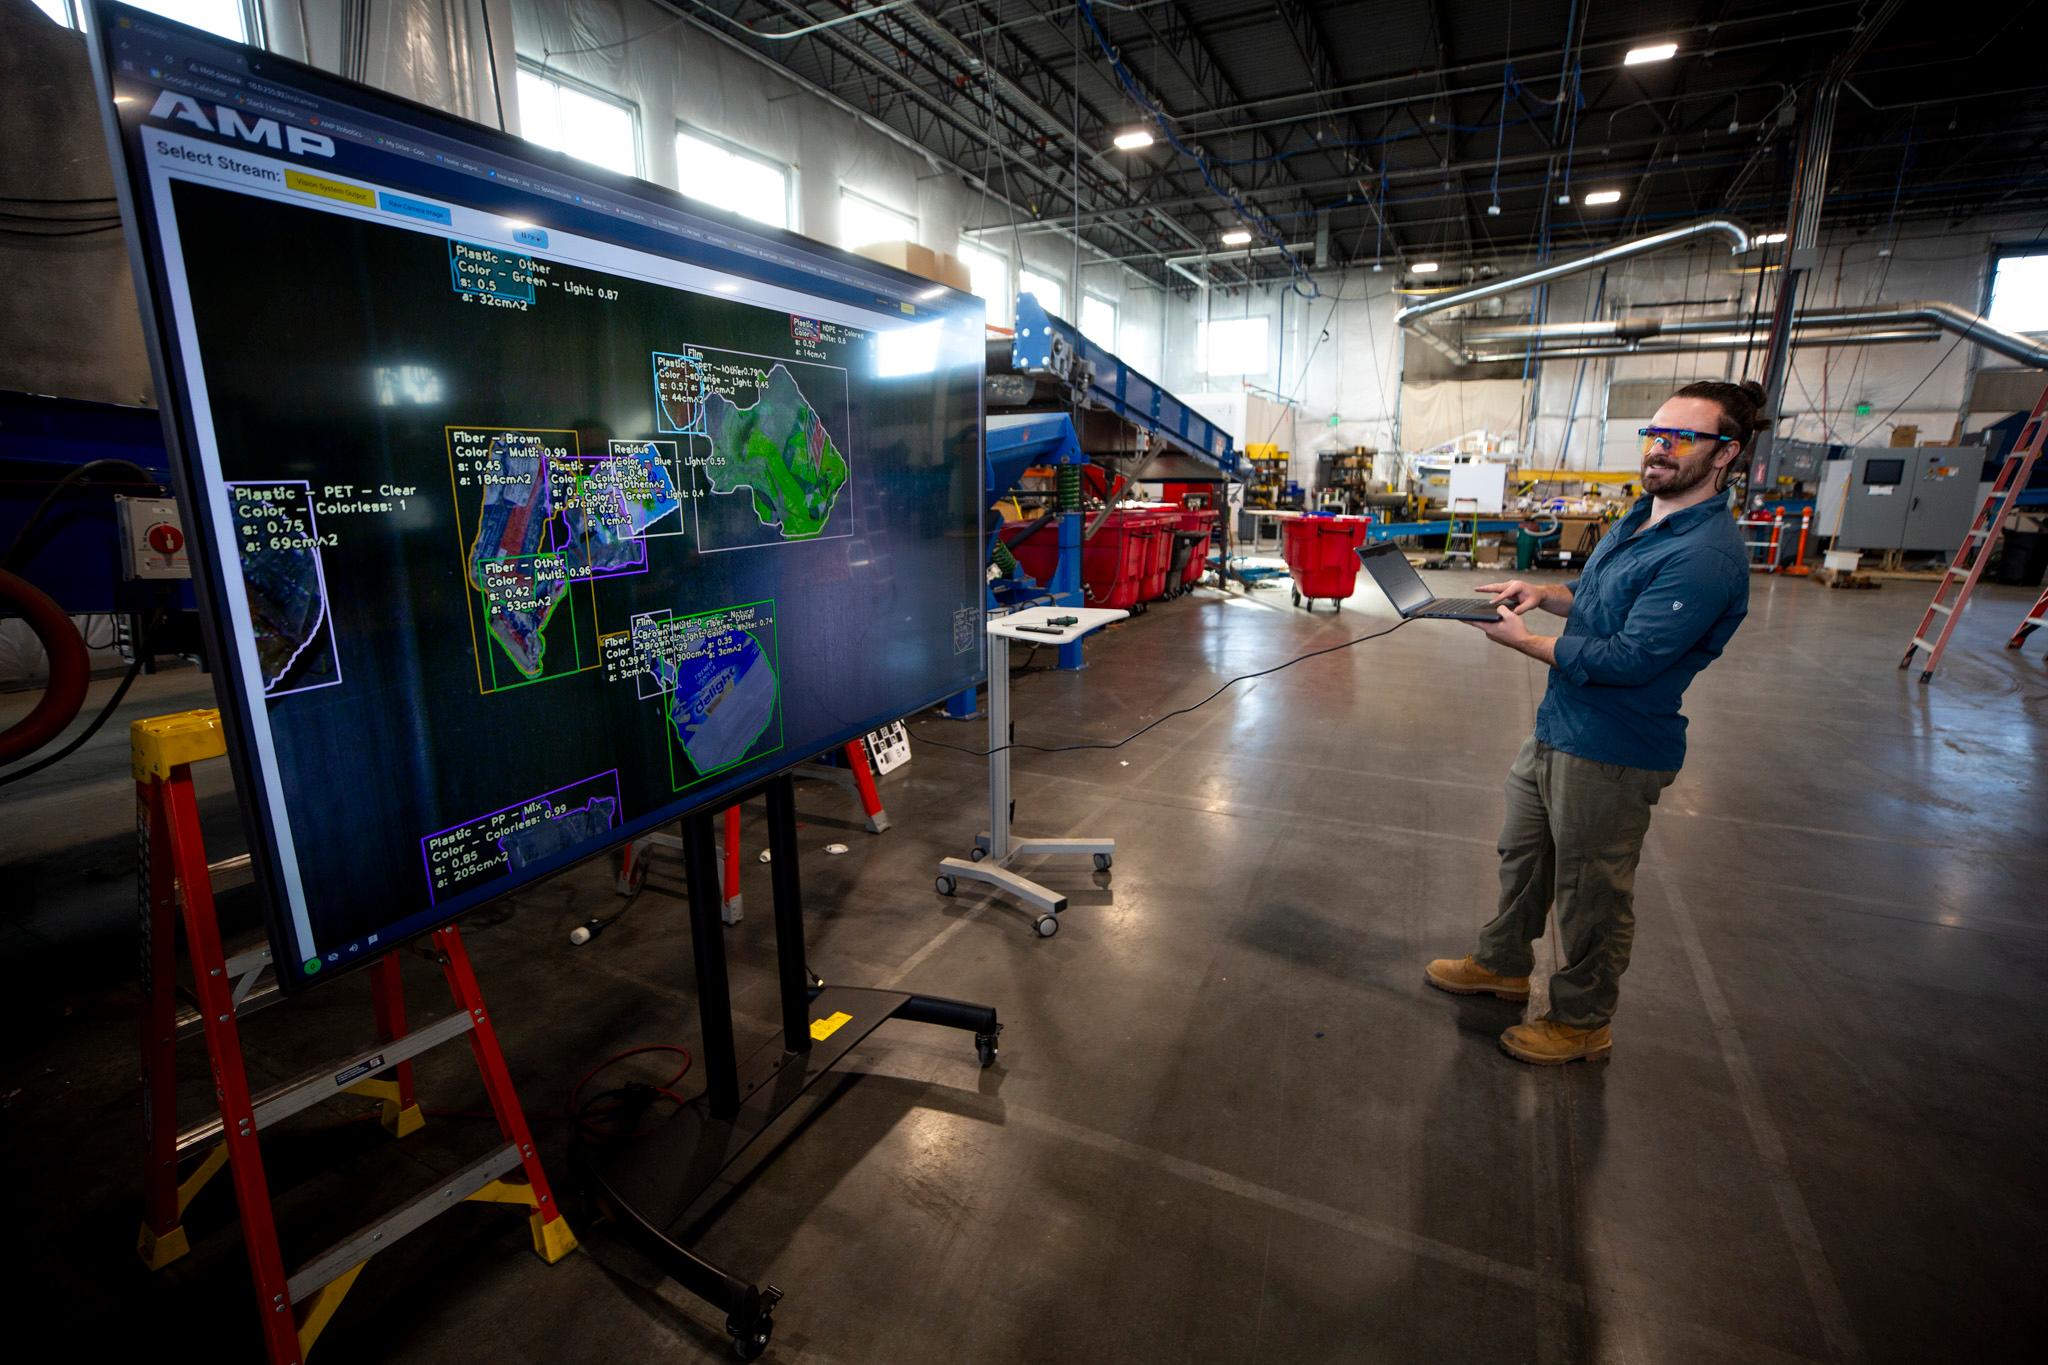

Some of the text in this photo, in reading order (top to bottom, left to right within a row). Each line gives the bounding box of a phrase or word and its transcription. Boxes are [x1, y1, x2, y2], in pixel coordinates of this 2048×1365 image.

[149, 90, 336, 158] AMP
[157, 141, 281, 182] Select Stream:
[319, 183, 345, 196] System
[345, 190, 368, 200] Output
[402, 203, 425, 214] Camera
[456, 245, 551, 274] Plastic Other
[458, 260, 619, 300] Color Green Light: 0.87
[477, 277, 497, 292] 0.5
[479, 292, 528, 311] 32cm^2
[794, 318, 813, 329] Plastic
[794, 327, 809, 337] Color
[820, 333, 836, 343] White:
[688, 348, 703, 359] Film
[657, 356, 685, 369] Plastic
[658, 368, 680, 379] Color
[732, 378, 752, 388] Light:
[671, 381, 688, 391] 0.57
[453, 432, 541, 444] Fiber Brown
[455, 446, 567, 458] Color Multi: 0.99
[614, 444, 649, 454] Residue
[474, 461, 500, 471] 0.45
[549, 461, 584, 471] Plastic
[616, 457, 726, 467] Color Blue Light: 0.55
[477, 474, 531, 485] 184cm^2
[551, 474, 576, 484] Color
[629, 469, 648, 478] 0.48
[583, 480, 607, 489] Fiber
[235, 484, 416, 501] Plastic PET Clear
[585, 490, 704, 502] Color Green Light: 0.4
[239, 499, 406, 518] Color Colorless: 1
[599, 504, 619, 513] 0.27
[266, 520, 304, 533] 0.75
[601, 515, 632, 526] 1cm^2
[245, 533, 338, 552] a: 69cm^2
[485, 558, 564, 575] Fiber Other
[487, 565, 591, 588] Color Multi: 0.96
[505, 586, 530, 599] 0.42
[506, 596, 551, 612] 53cm^2
[636, 617, 653, 627] Film
[604, 637, 629, 648] Fiber
[717, 636, 732, 647] 0.35
[606, 648, 630, 660] Color
[619, 656, 639, 669] 0.39
[621, 664, 651, 679] 3cm^2
[429, 802, 542, 850] Plastic PP Mix
[432, 804, 567, 862] Color Colorless: 0.99
[451, 850, 478, 869] 0.85
[453, 851, 509, 882] 205cm^2
